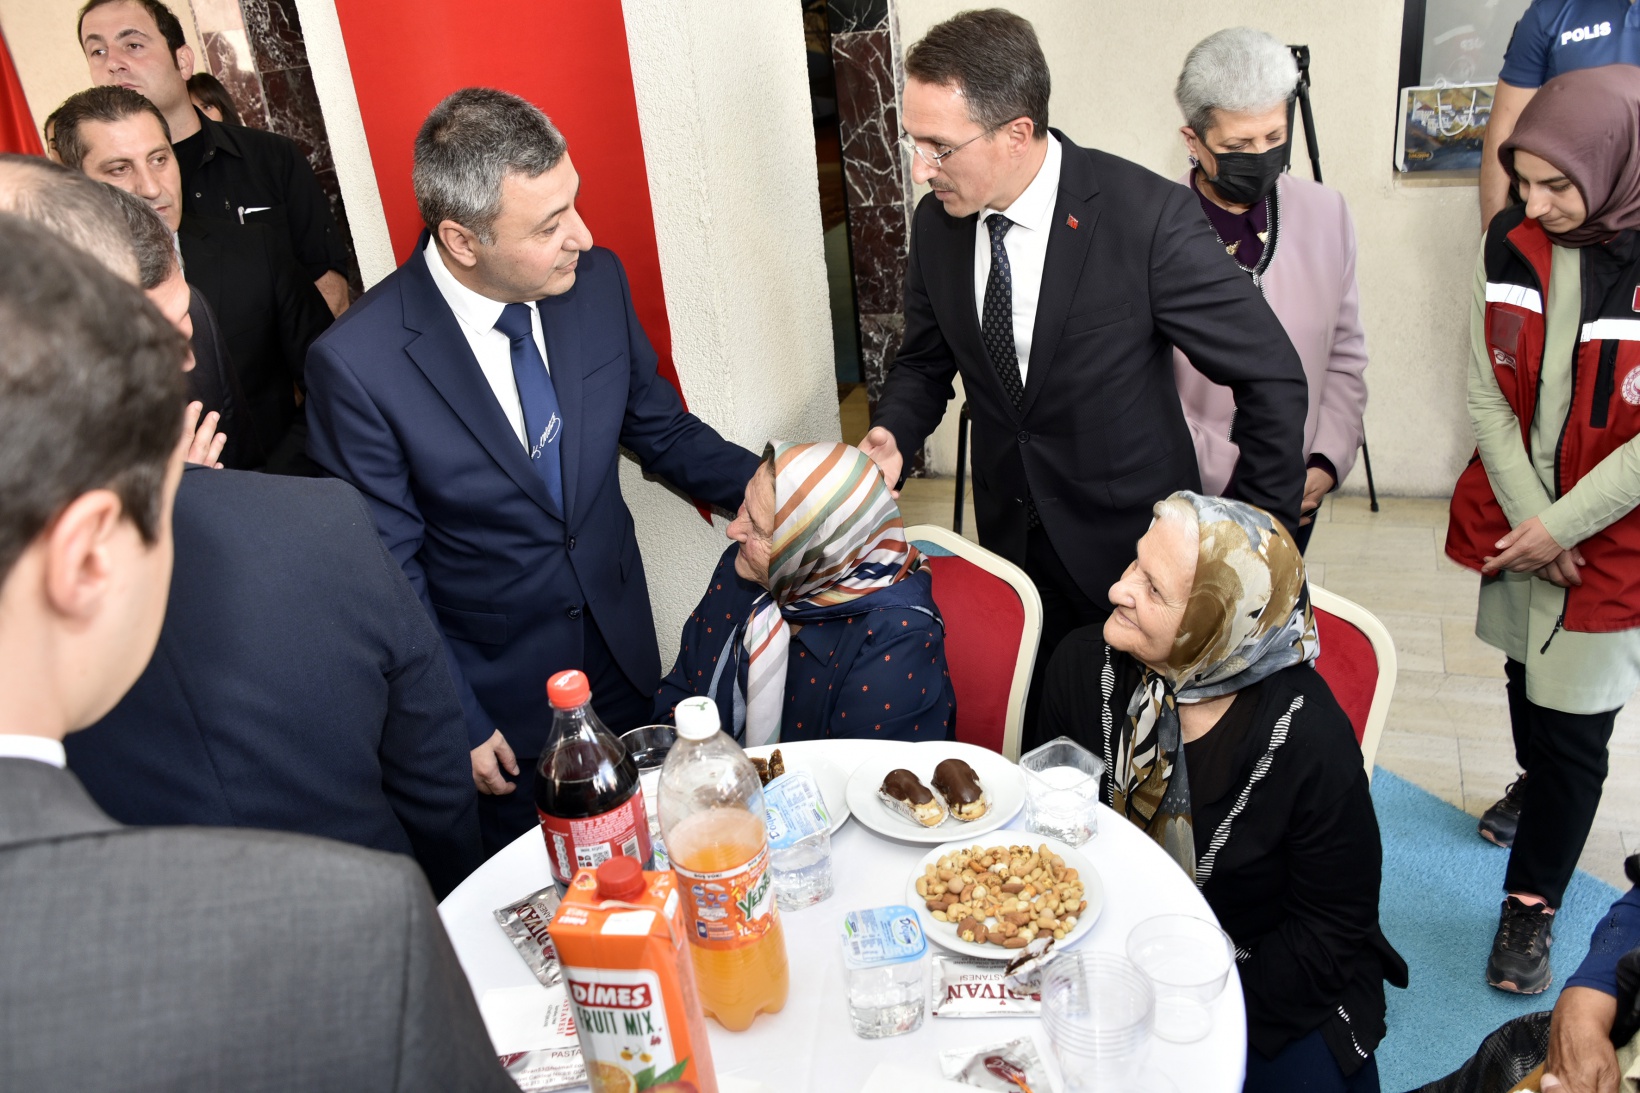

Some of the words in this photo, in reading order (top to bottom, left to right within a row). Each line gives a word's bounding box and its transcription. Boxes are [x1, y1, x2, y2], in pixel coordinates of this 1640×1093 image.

[959, 973, 1006, 982] ASTANESİ
[556, 998, 570, 1035] ASTANESİ
[623, 1010, 654, 1036] MIX
[551, 1048, 582, 1059] PASTA
